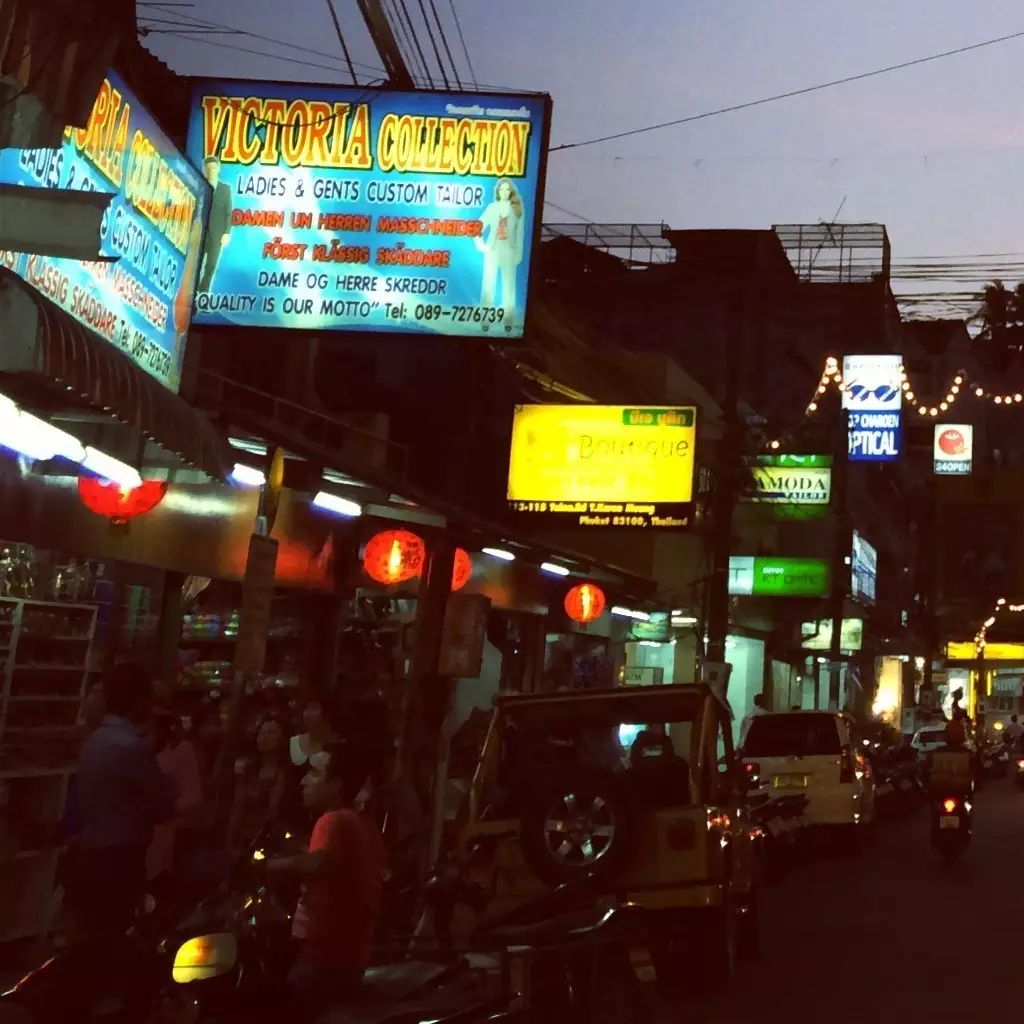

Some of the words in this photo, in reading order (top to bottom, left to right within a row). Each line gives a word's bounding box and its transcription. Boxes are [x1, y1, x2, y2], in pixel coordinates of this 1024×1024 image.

[202, 95, 374, 170] VICTORIA
[376, 113, 531, 177] COLLECTION
[237, 175, 287, 197] LADIES
[295, 179, 305, 198] &
[313, 179, 360, 201] GENTS
[367, 182, 428, 203] CUSTOM
[437, 185, 484, 206] TAILOR
[231, 209, 284, 228] DAMEN
[291, 212, 313, 230] UN
[318, 213, 371, 232] HERREN
[377, 215, 484, 238] MASSCHNEIDER
[258, 271, 300, 289] DAME
[306, 273, 329, 290] OG
[336, 275, 378, 292] HERRE
[384, 276, 448, 295] SKREDDR
[263, 297, 275, 313] IS
[283, 297, 314, 315] OUR
[385, 302, 408, 320] Tel:
[415, 304, 505, 323] 089-7276739
[579, 434, 689, 459] Boutque
